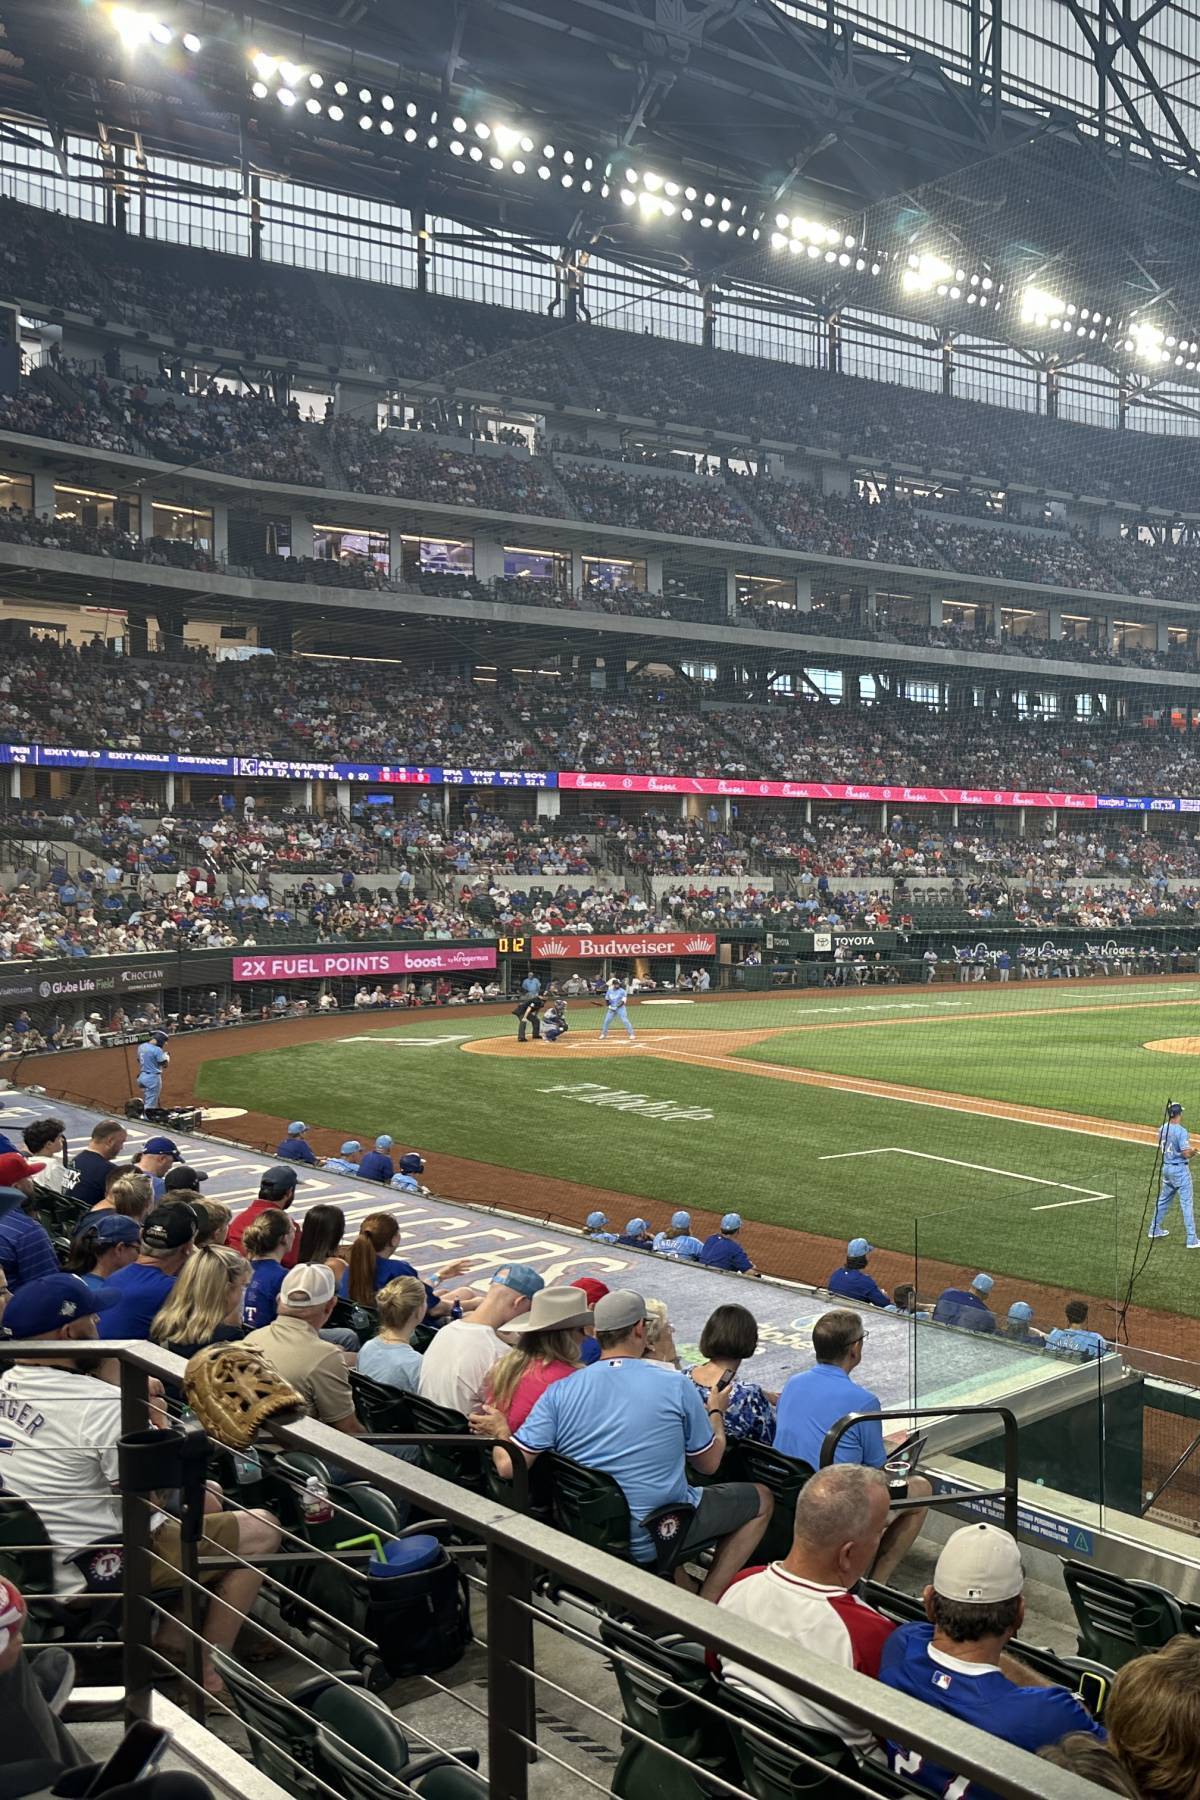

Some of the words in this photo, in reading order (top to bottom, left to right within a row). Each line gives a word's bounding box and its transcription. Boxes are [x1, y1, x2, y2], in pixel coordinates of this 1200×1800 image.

[9, 746, 30, 755] RBI
[44, 748, 71, 756] EXIT
[70, 749, 101, 758] VELO
[108, 752, 132, 760] EXIT
[133, 753, 170, 763] ANGLE
[177, 756, 228, 766] DISTANCE
[258, 761, 289, 769] ALEC
[289, 762, 335, 772] MARSH
[469, 770, 496, 778] WHIP
[443, 776, 463, 784] 4.37
[473, 777, 493, 785] 1.17
[525, 778, 545, 786] 22.5
[512, 936, 524, 953] 12
[774, 938, 790, 946] TOYOTA
[834, 936, 875, 946] TOYOTA
[579, 939, 675, 956] Budweiser
[241, 960, 265, 976] 2X
[271, 959, 319, 975] FUEL
[324, 956, 389, 973] POINTS
[124, 970, 164, 982] CHOCTAW
[52, 982, 78, 994] Globe
[79, 979, 95, 992] Life
[96, 976, 115, 990] Field
